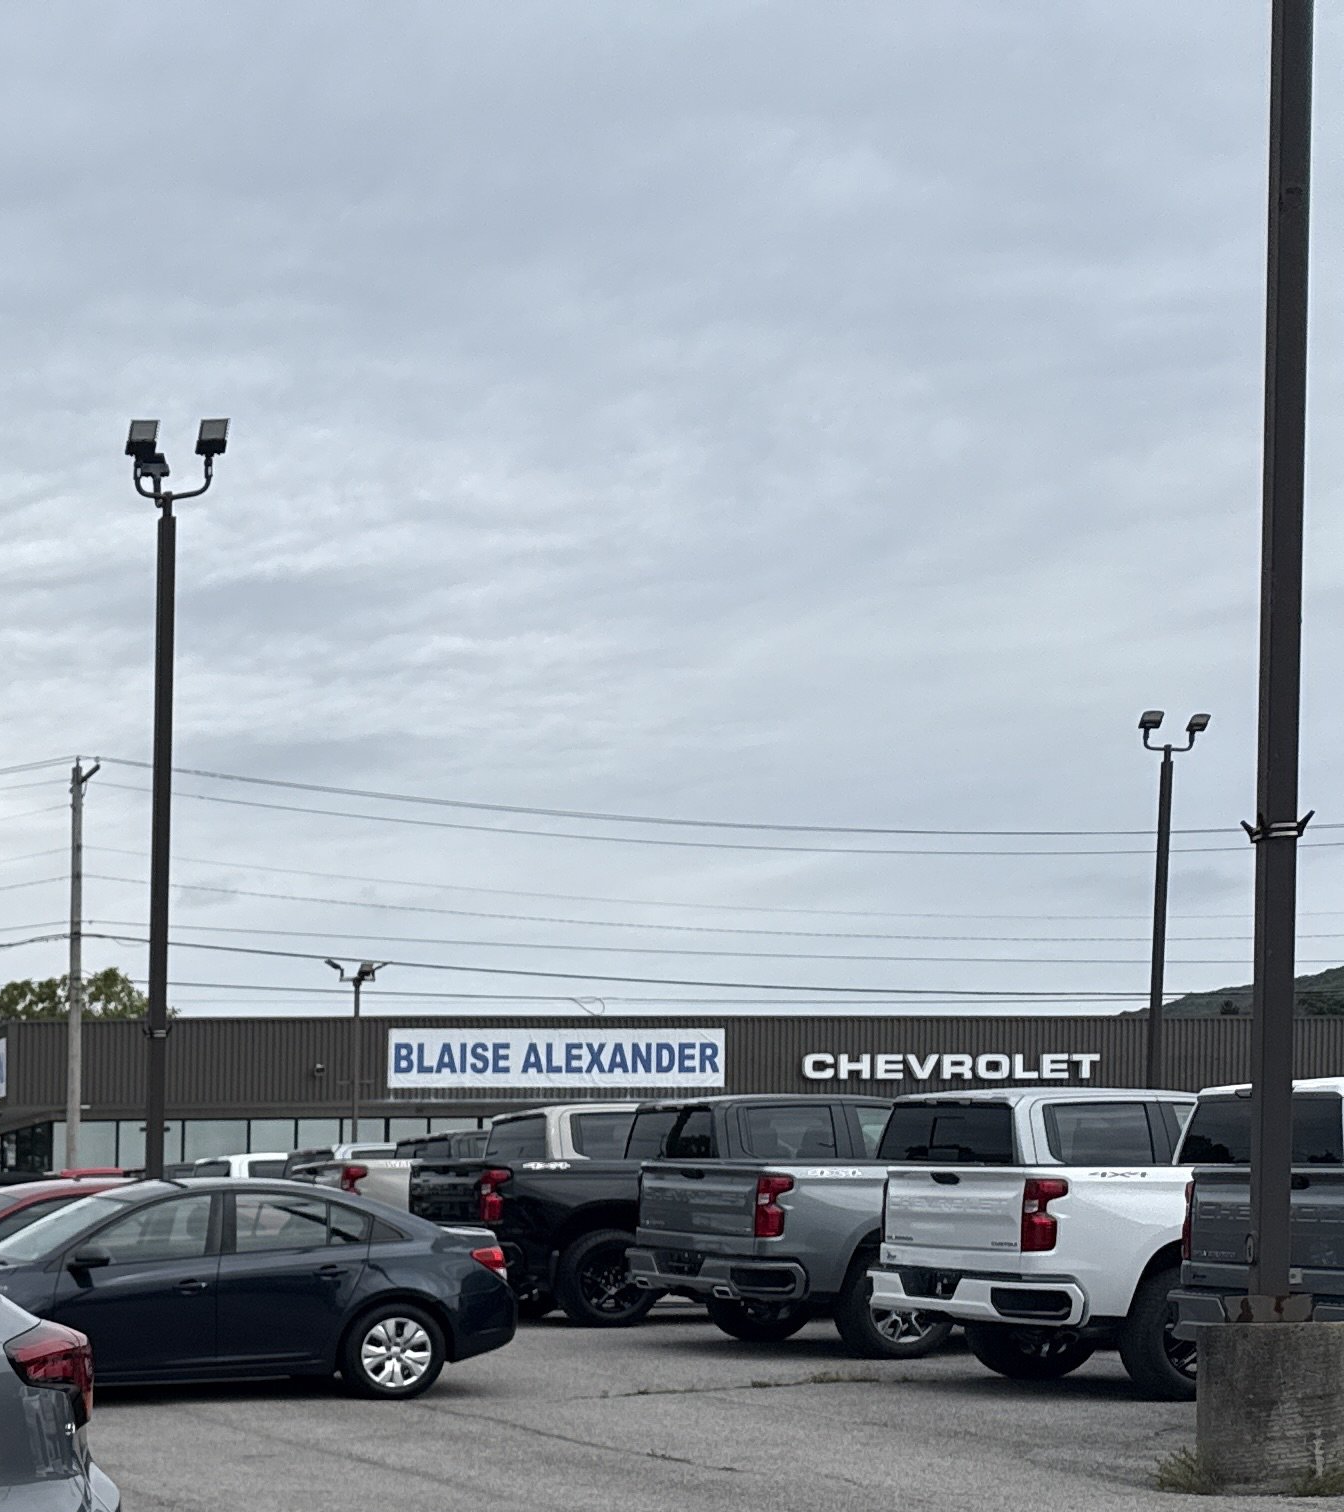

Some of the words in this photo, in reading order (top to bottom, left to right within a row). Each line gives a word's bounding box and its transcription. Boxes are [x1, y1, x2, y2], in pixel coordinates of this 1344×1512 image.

[393, 1042, 512, 1074] BLAISE
[520, 1042, 720, 1075] ALEXANDER
[802, 1052, 1102, 1081] CHEVROLET
